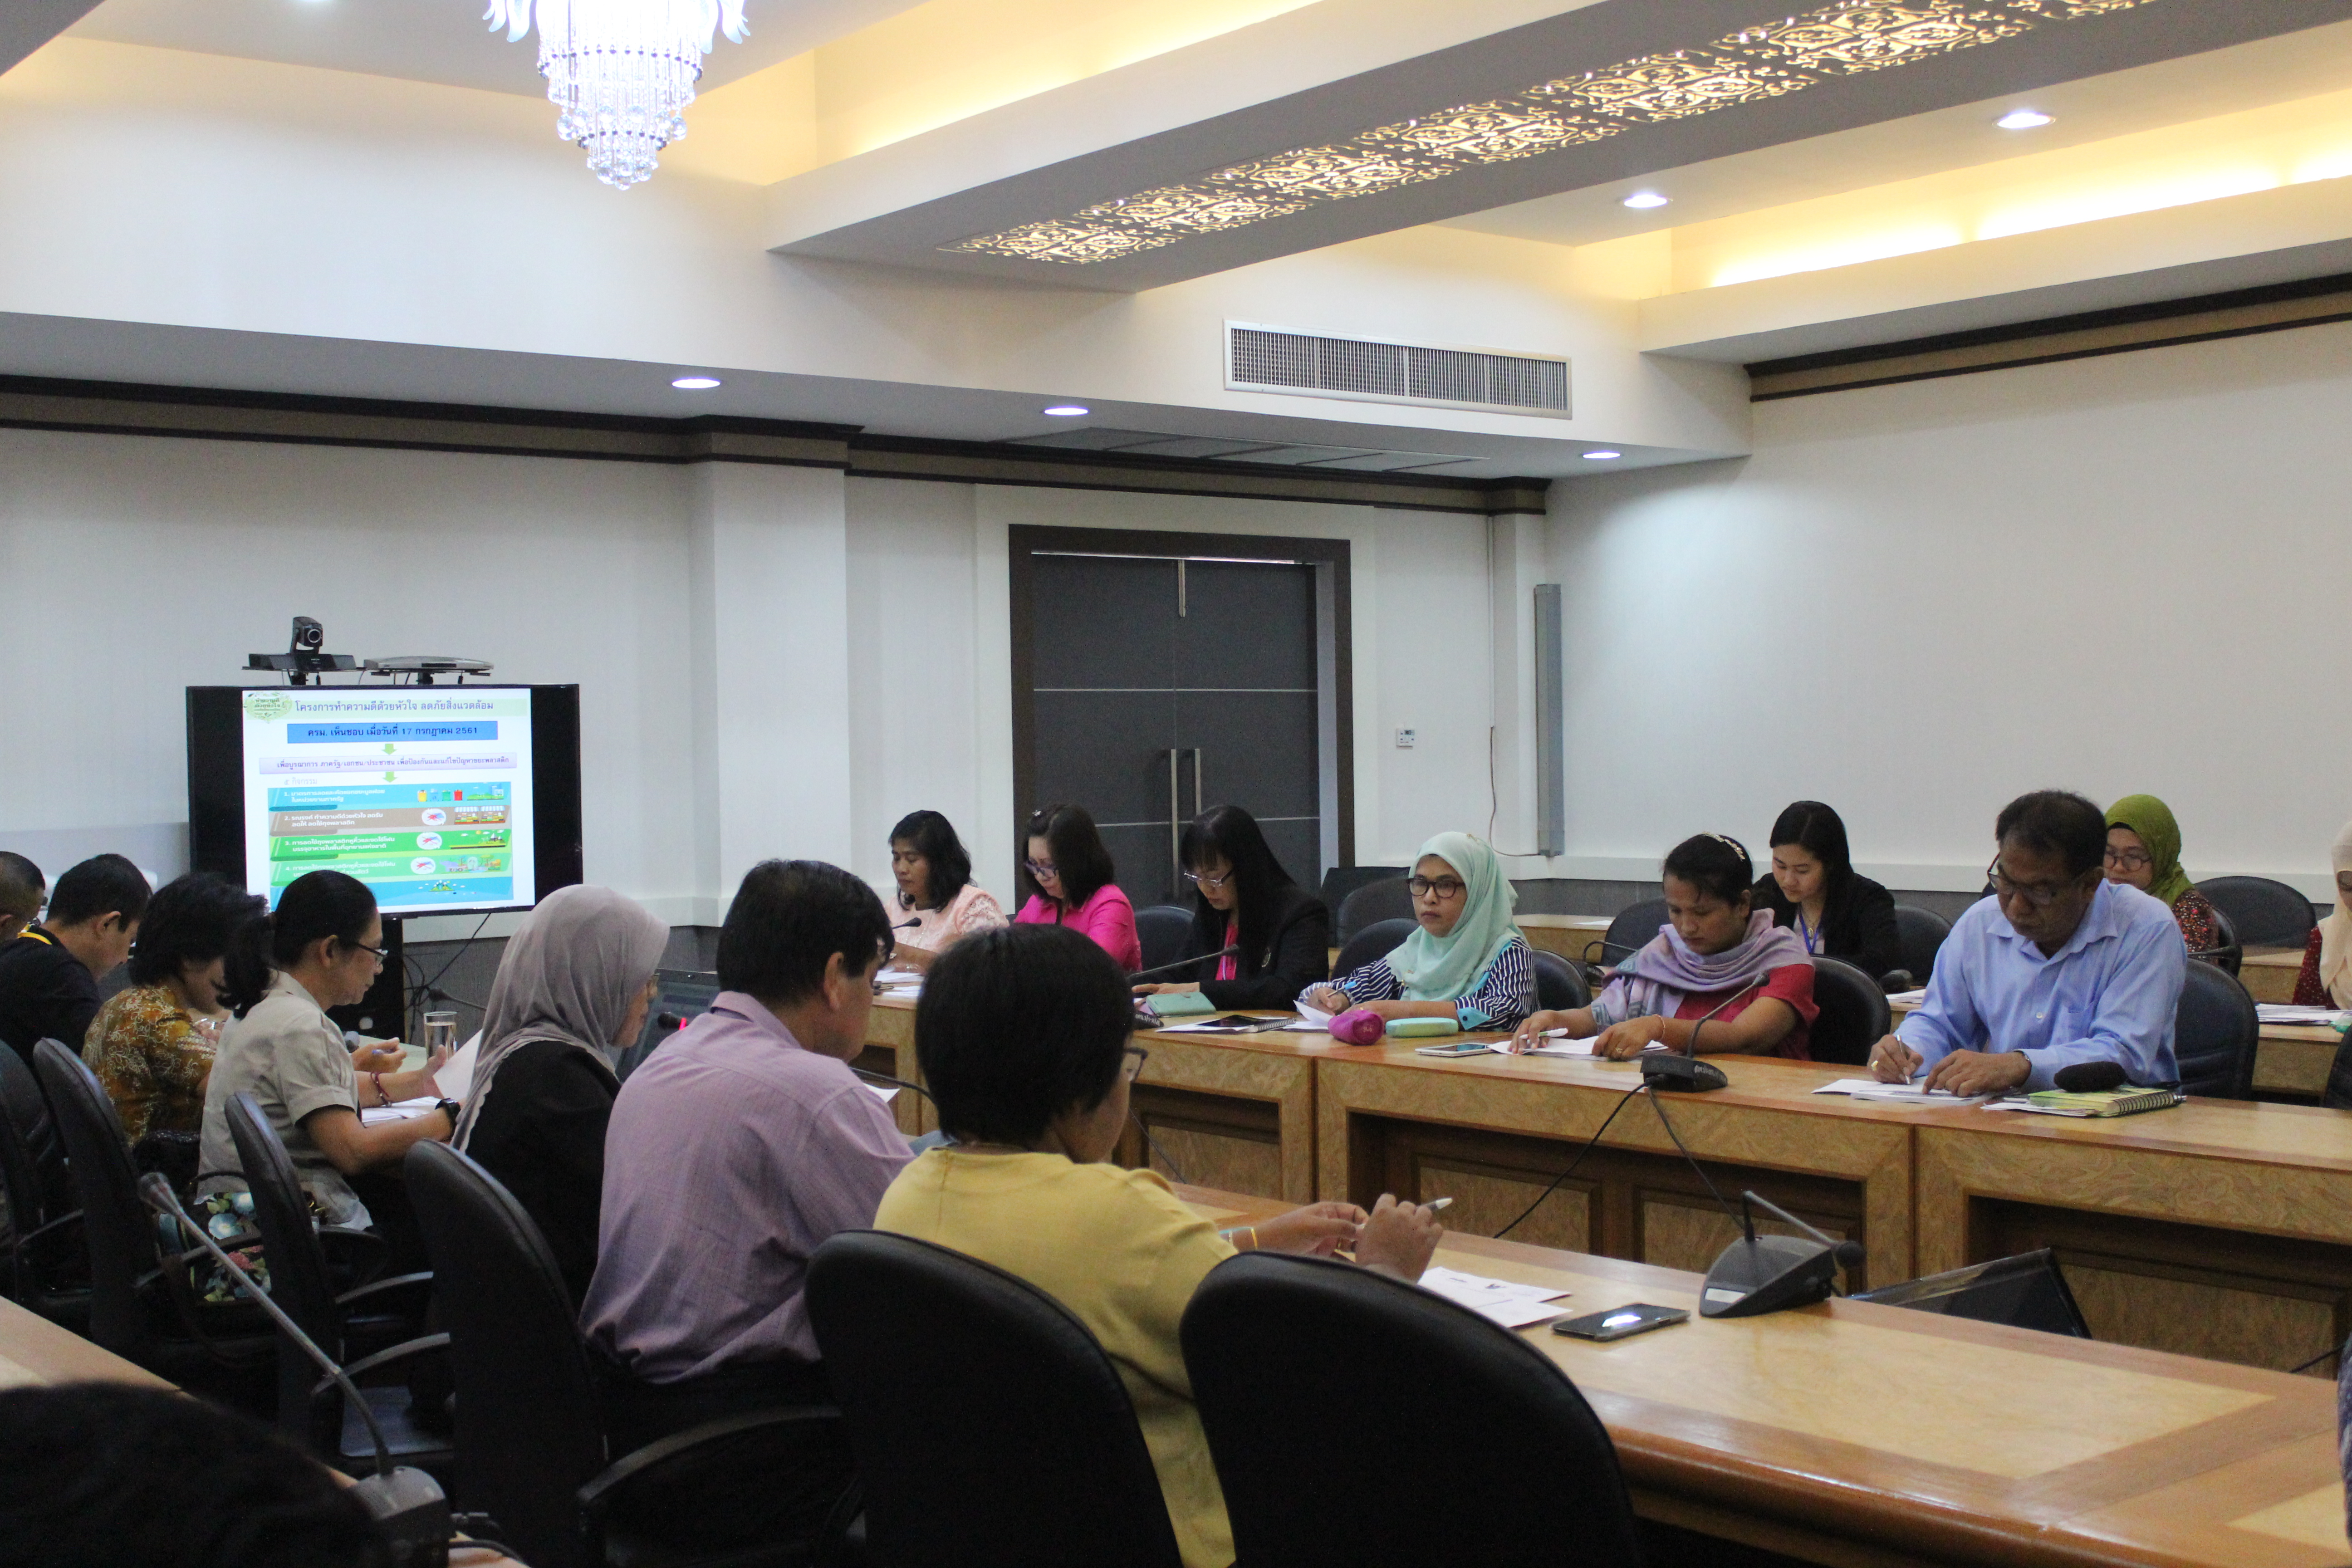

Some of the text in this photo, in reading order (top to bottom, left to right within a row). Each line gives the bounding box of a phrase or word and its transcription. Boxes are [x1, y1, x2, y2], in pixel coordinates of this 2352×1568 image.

[295, 697, 494, 712] โครงการทำความดีด้วยหัวใจ ลดภัยสิ่งแวดล้อม
[331, 726, 363, 736] เห็นชอบ
[367, 724, 398, 735] เมื่อวันที่
[416, 727, 453, 736] กรกฎาคม
